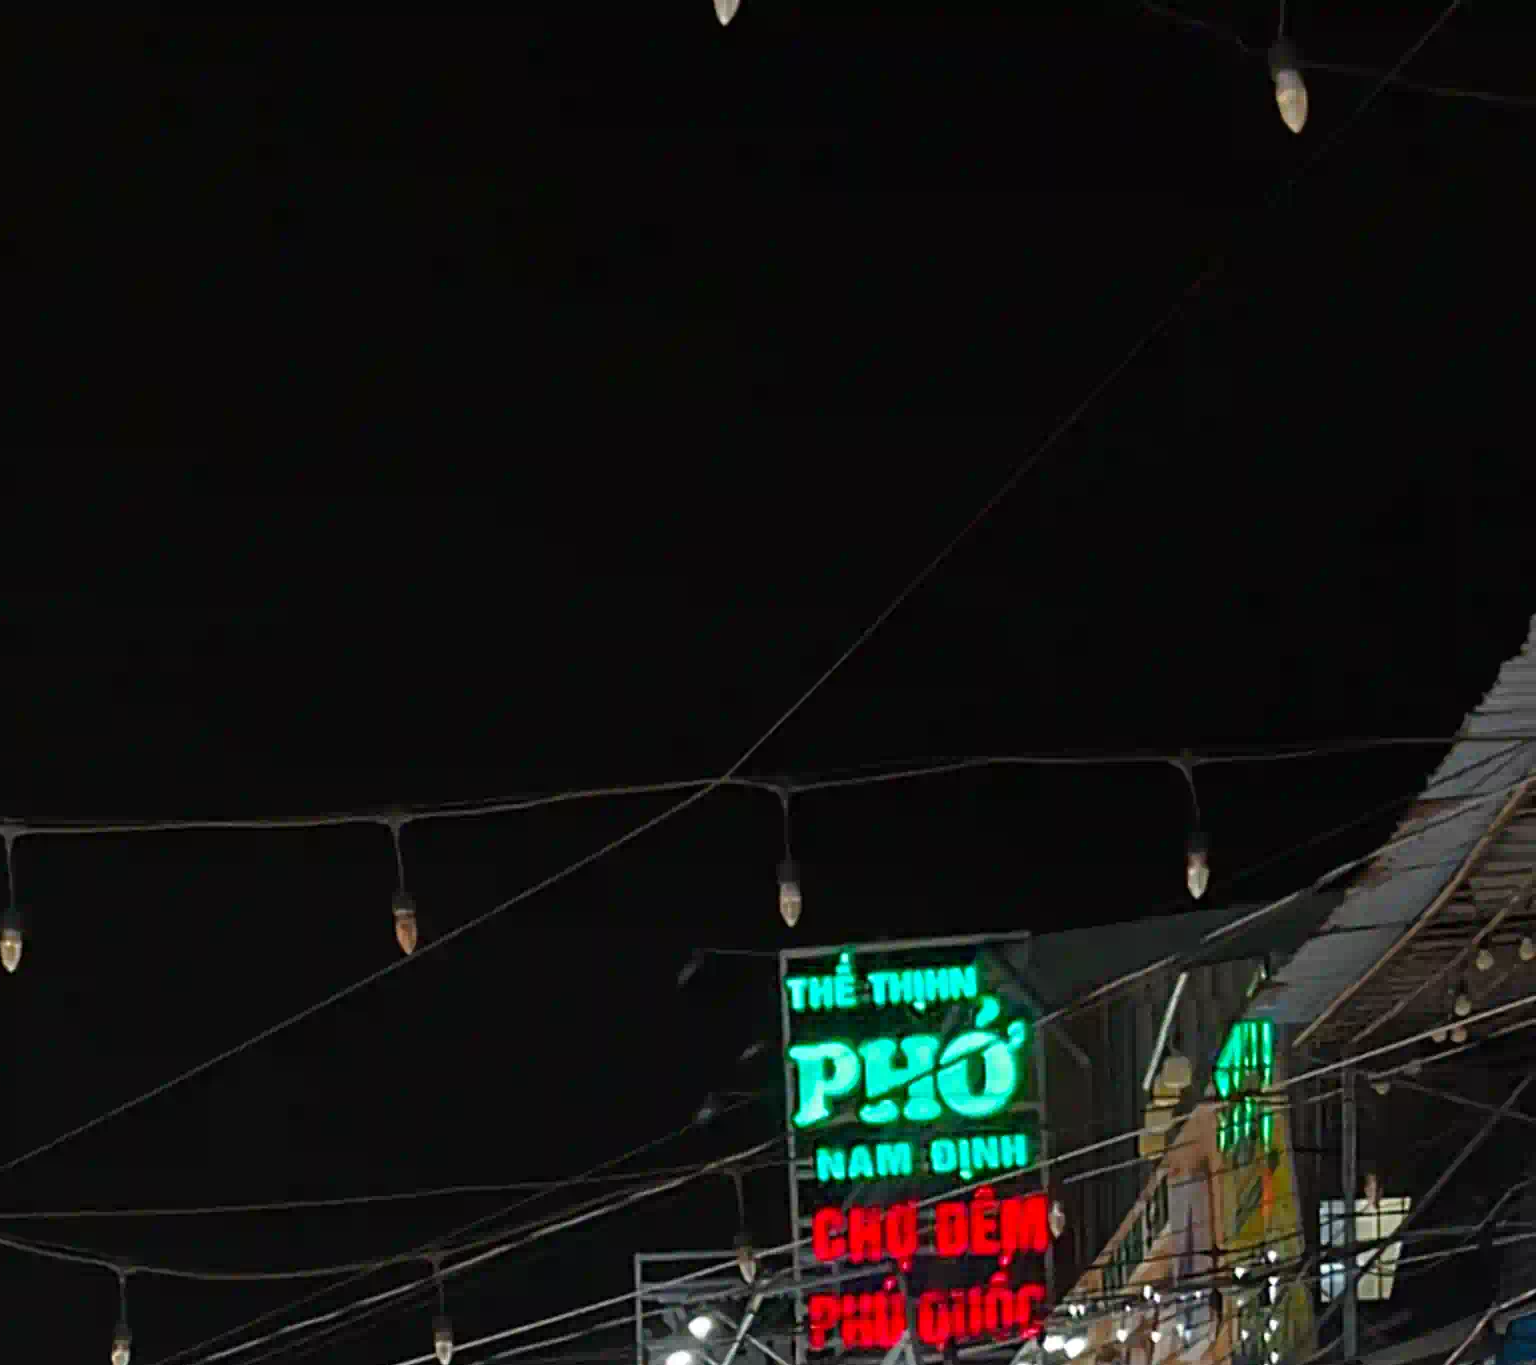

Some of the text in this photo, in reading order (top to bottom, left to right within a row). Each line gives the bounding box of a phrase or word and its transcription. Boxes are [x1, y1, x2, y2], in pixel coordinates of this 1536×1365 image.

[789, 997, 1026, 1128] PHỞ
[816, 1134, 1028, 1182] NAM ĐỊNH
